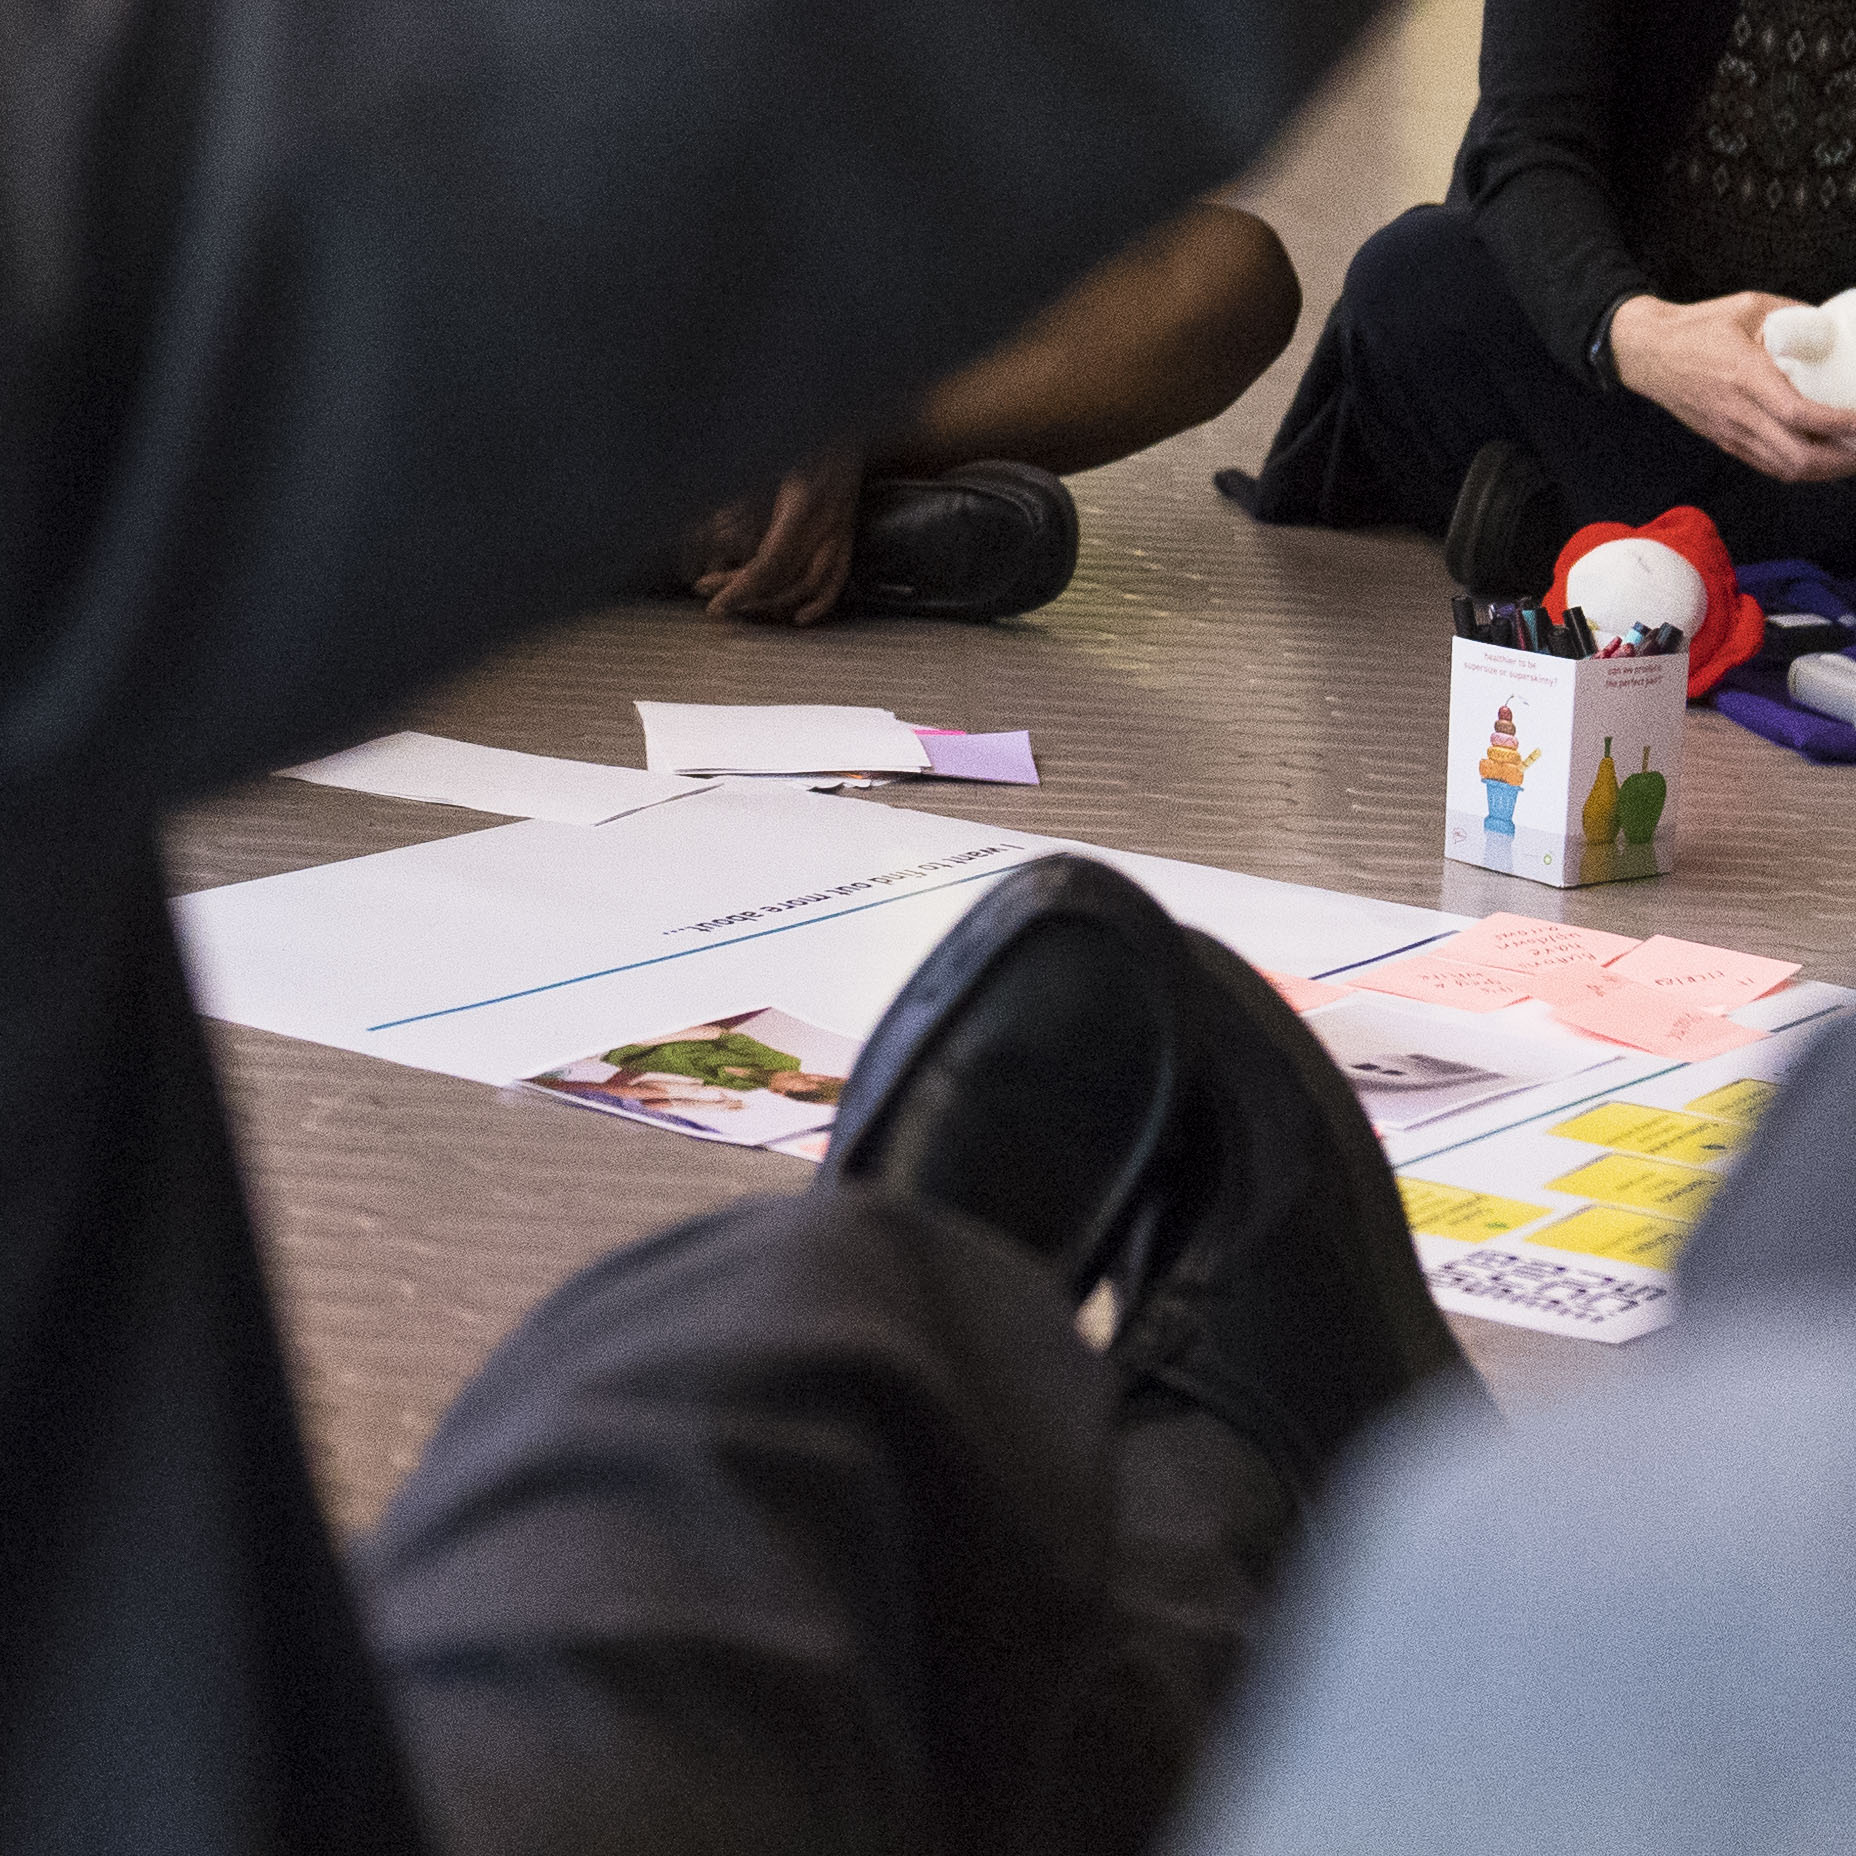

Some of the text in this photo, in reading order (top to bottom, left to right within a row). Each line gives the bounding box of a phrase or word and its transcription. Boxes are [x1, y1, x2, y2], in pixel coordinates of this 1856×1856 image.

[950, 845, 1002, 864] want
[926, 859, 952, 871] to
[872, 867, 927, 885] find
[830, 881, 872, 896] out
[761, 892, 831, 912] more
